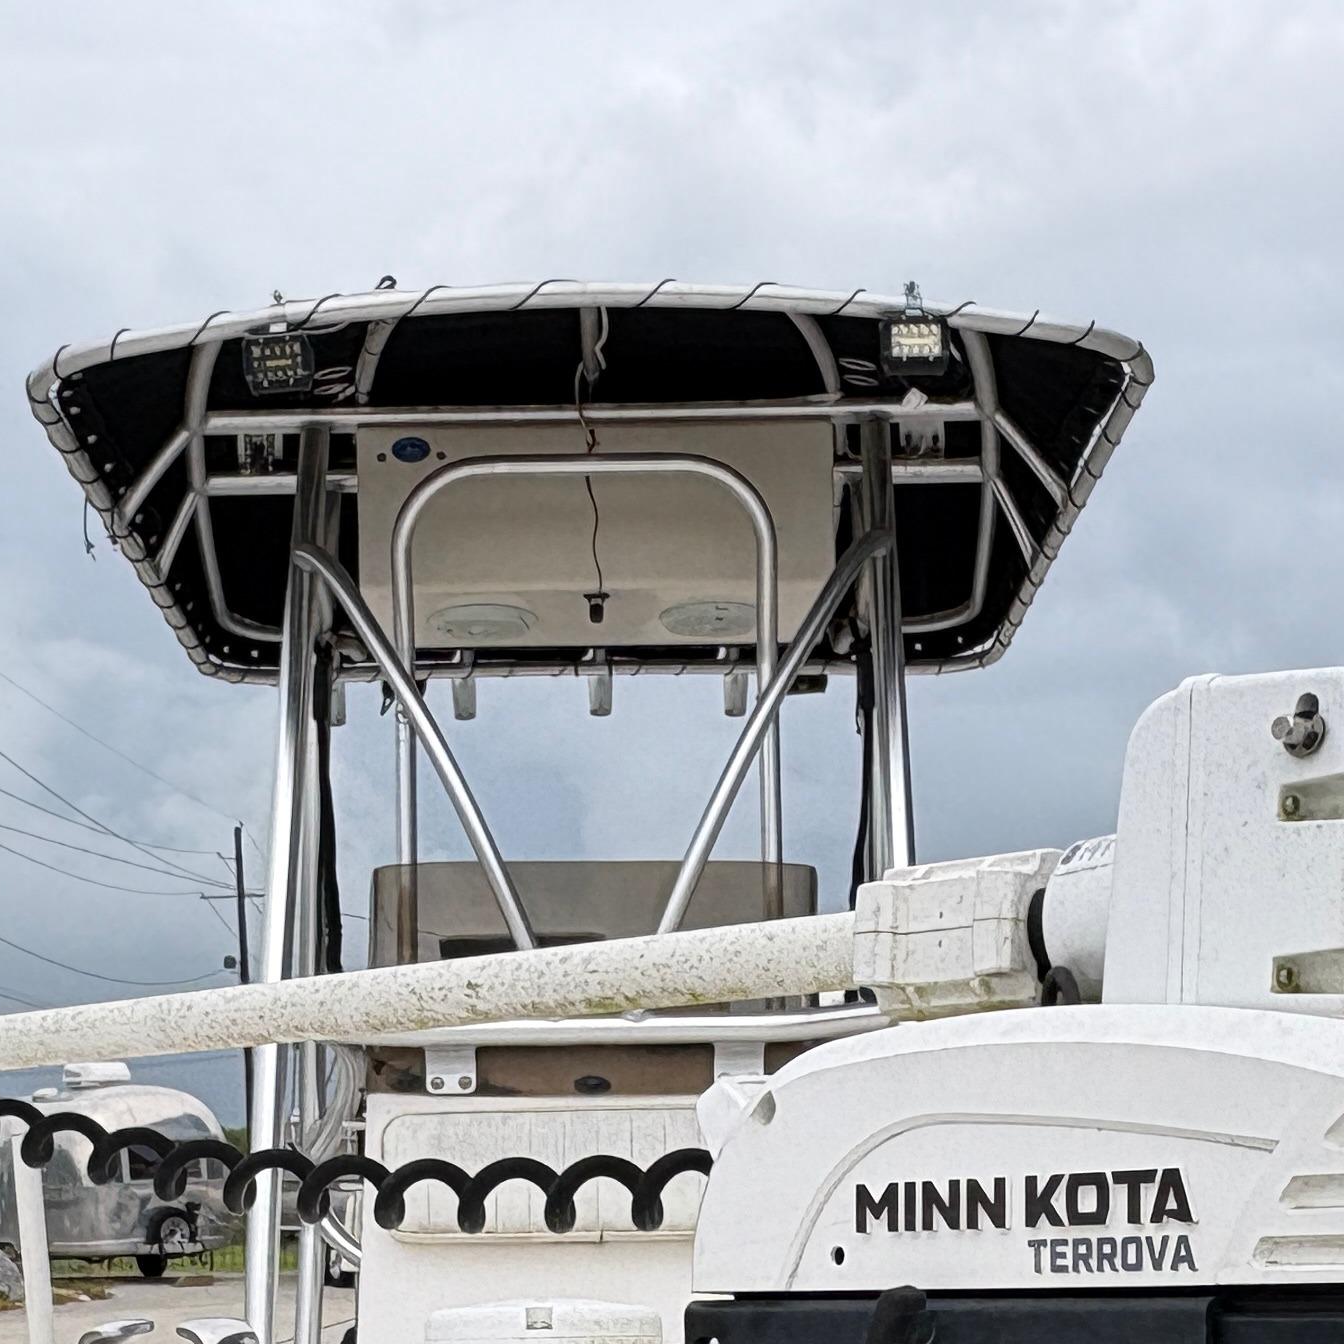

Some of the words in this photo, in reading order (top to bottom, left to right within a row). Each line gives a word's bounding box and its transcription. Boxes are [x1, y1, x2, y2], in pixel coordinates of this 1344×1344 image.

[855, 1177, 1008, 1234] MINN
[1024, 1168, 1196, 1228] KOTA
[1027, 1235, 1198, 1274] TERROVA
